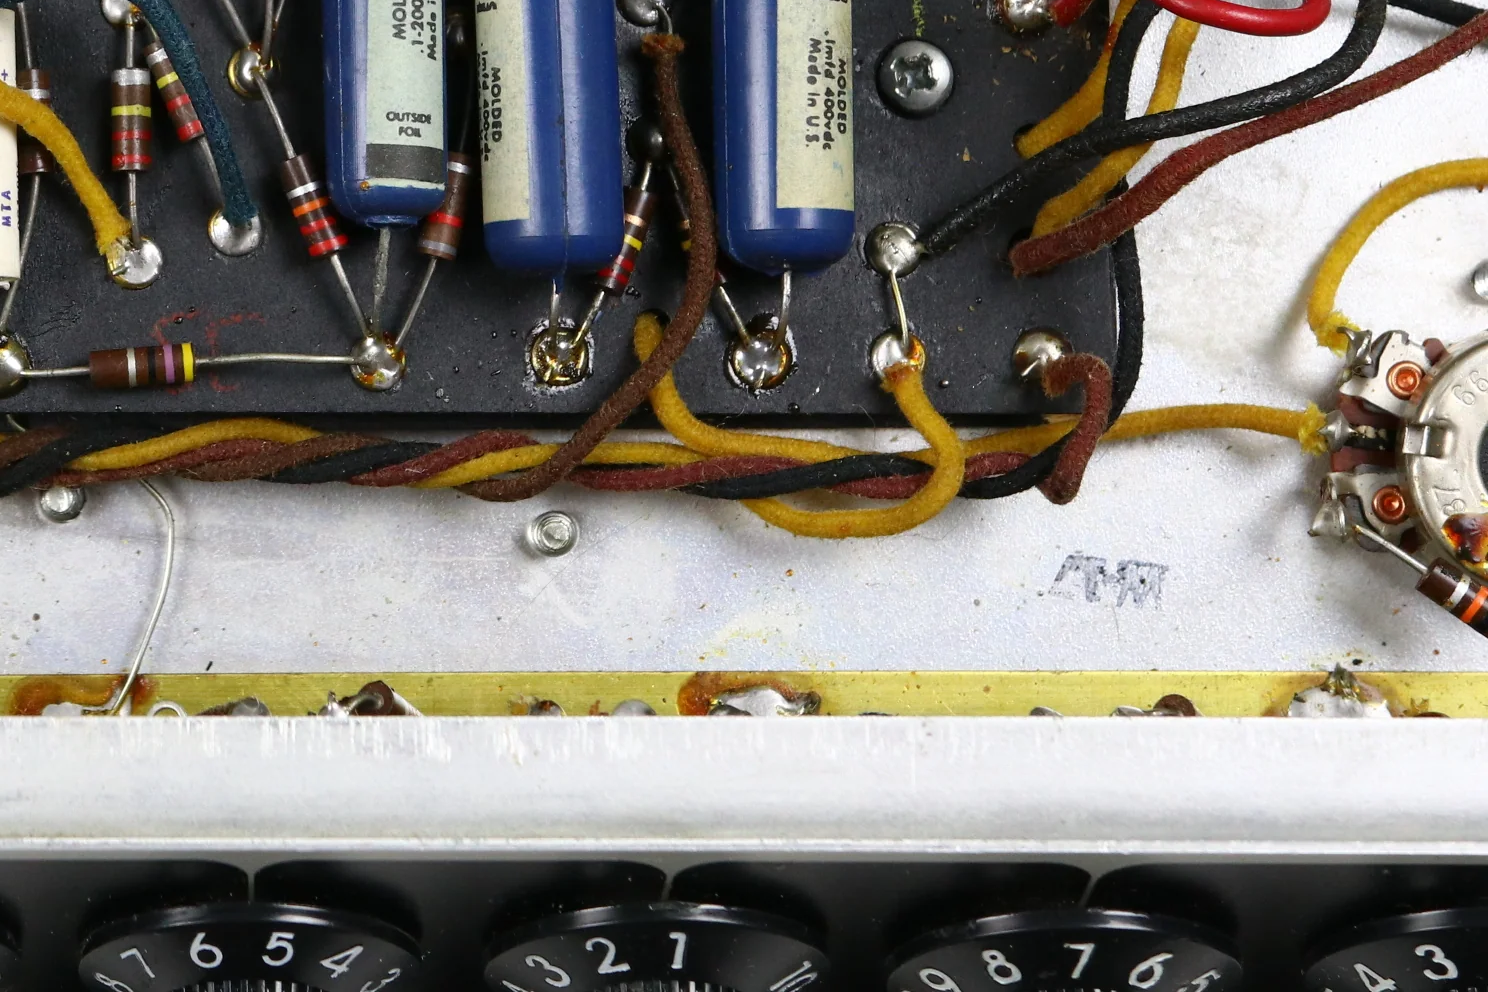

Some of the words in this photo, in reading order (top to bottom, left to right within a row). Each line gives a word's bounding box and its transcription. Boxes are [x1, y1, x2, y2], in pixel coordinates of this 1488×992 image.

[426, 12, 437, 61] Made
[807, 38, 821, 86] Made
[386, 111, 432, 125] OUTSIDE
[491, 66, 502, 143] MOLDED
[822, 87, 835, 151] 400vdc
[837, 58, 847, 135] MOLDED
[398, 125, 422, 139] FOIL
[1, 190, 12, 227] MTA
[120, 948, 155, 978] 7
[189, 932, 223, 969] 6
[262, 932, 295, 967] 5
[320, 945, 364, 978] 4
[525, 955, 571, 988] 3
[585, 937, 631, 975] 2
[669, 932, 687, 969] 1
[982, 949, 1022, 985] 8
[1063, 943, 1095, 979] 7
[1128, 952, 1174, 989] 6
[1414, 944, 1459, 980] 3
